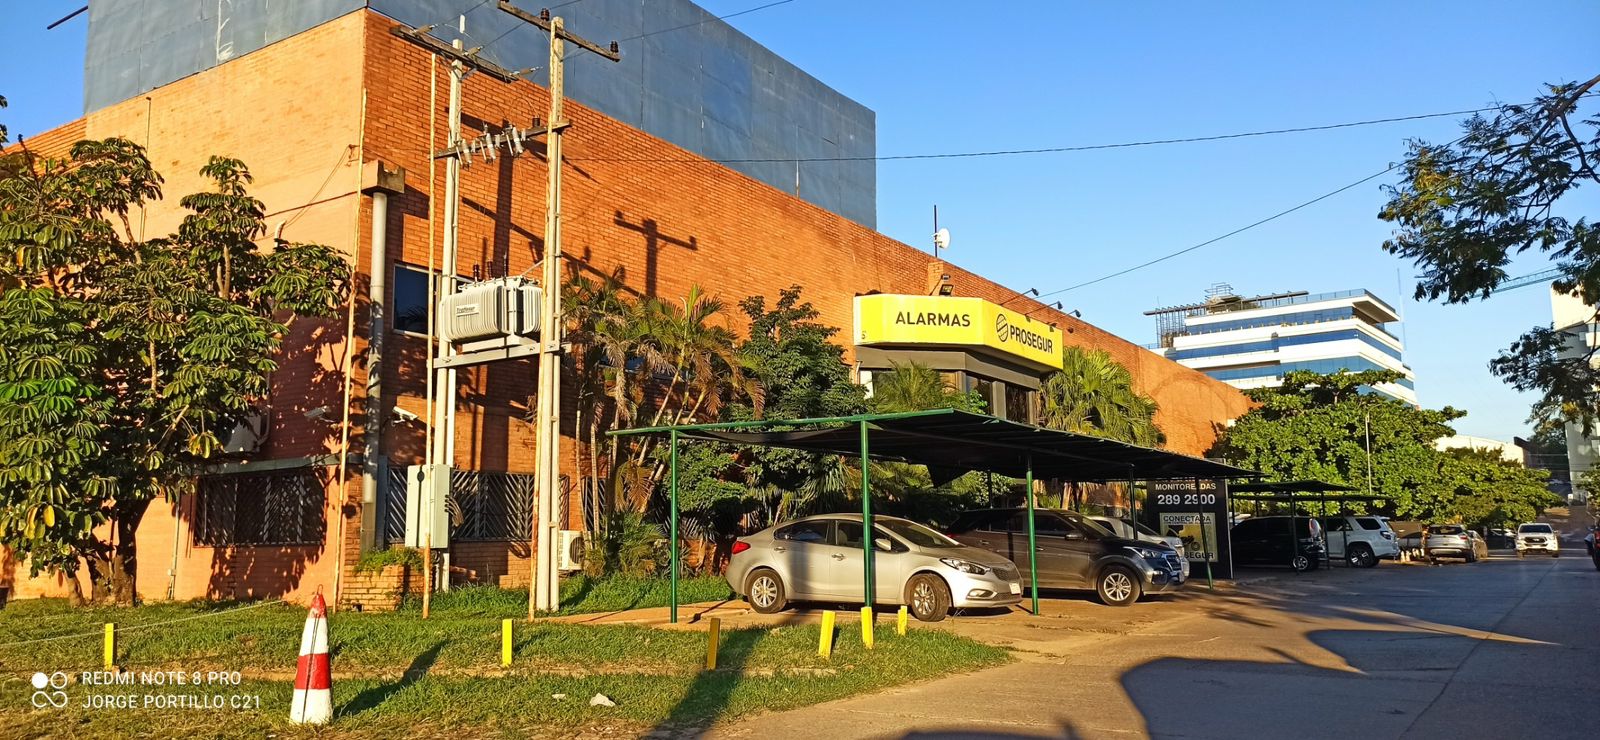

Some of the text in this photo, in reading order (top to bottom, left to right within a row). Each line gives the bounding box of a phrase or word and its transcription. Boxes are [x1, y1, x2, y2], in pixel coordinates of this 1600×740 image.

[895, 311, 971, 327] ALARMAS
[1010, 326, 1053, 354] PROSEGUR
[1155, 483, 1216, 491] MONITOREDAS
[1157, 493, 1216, 505] 289 2900
[1184, 551, 1214, 559] SEGUR
